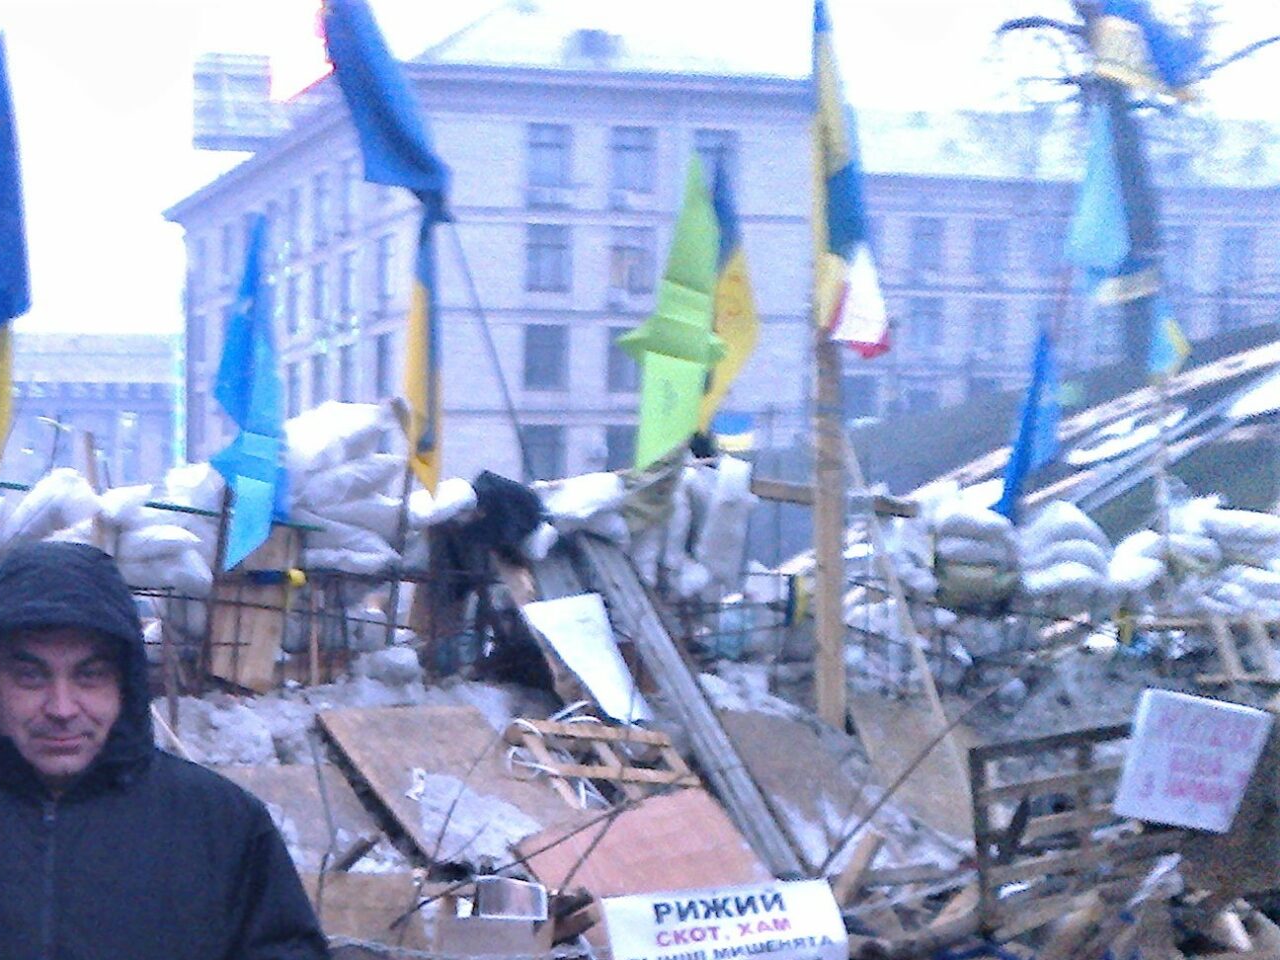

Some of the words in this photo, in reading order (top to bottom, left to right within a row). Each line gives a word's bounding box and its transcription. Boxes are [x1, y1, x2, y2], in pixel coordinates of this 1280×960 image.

[653, 889, 786, 925] РИЖИЙ
[737, 917, 792, 937] ХАМ
[712, 935, 835, 960] МИШЕНЯТА
